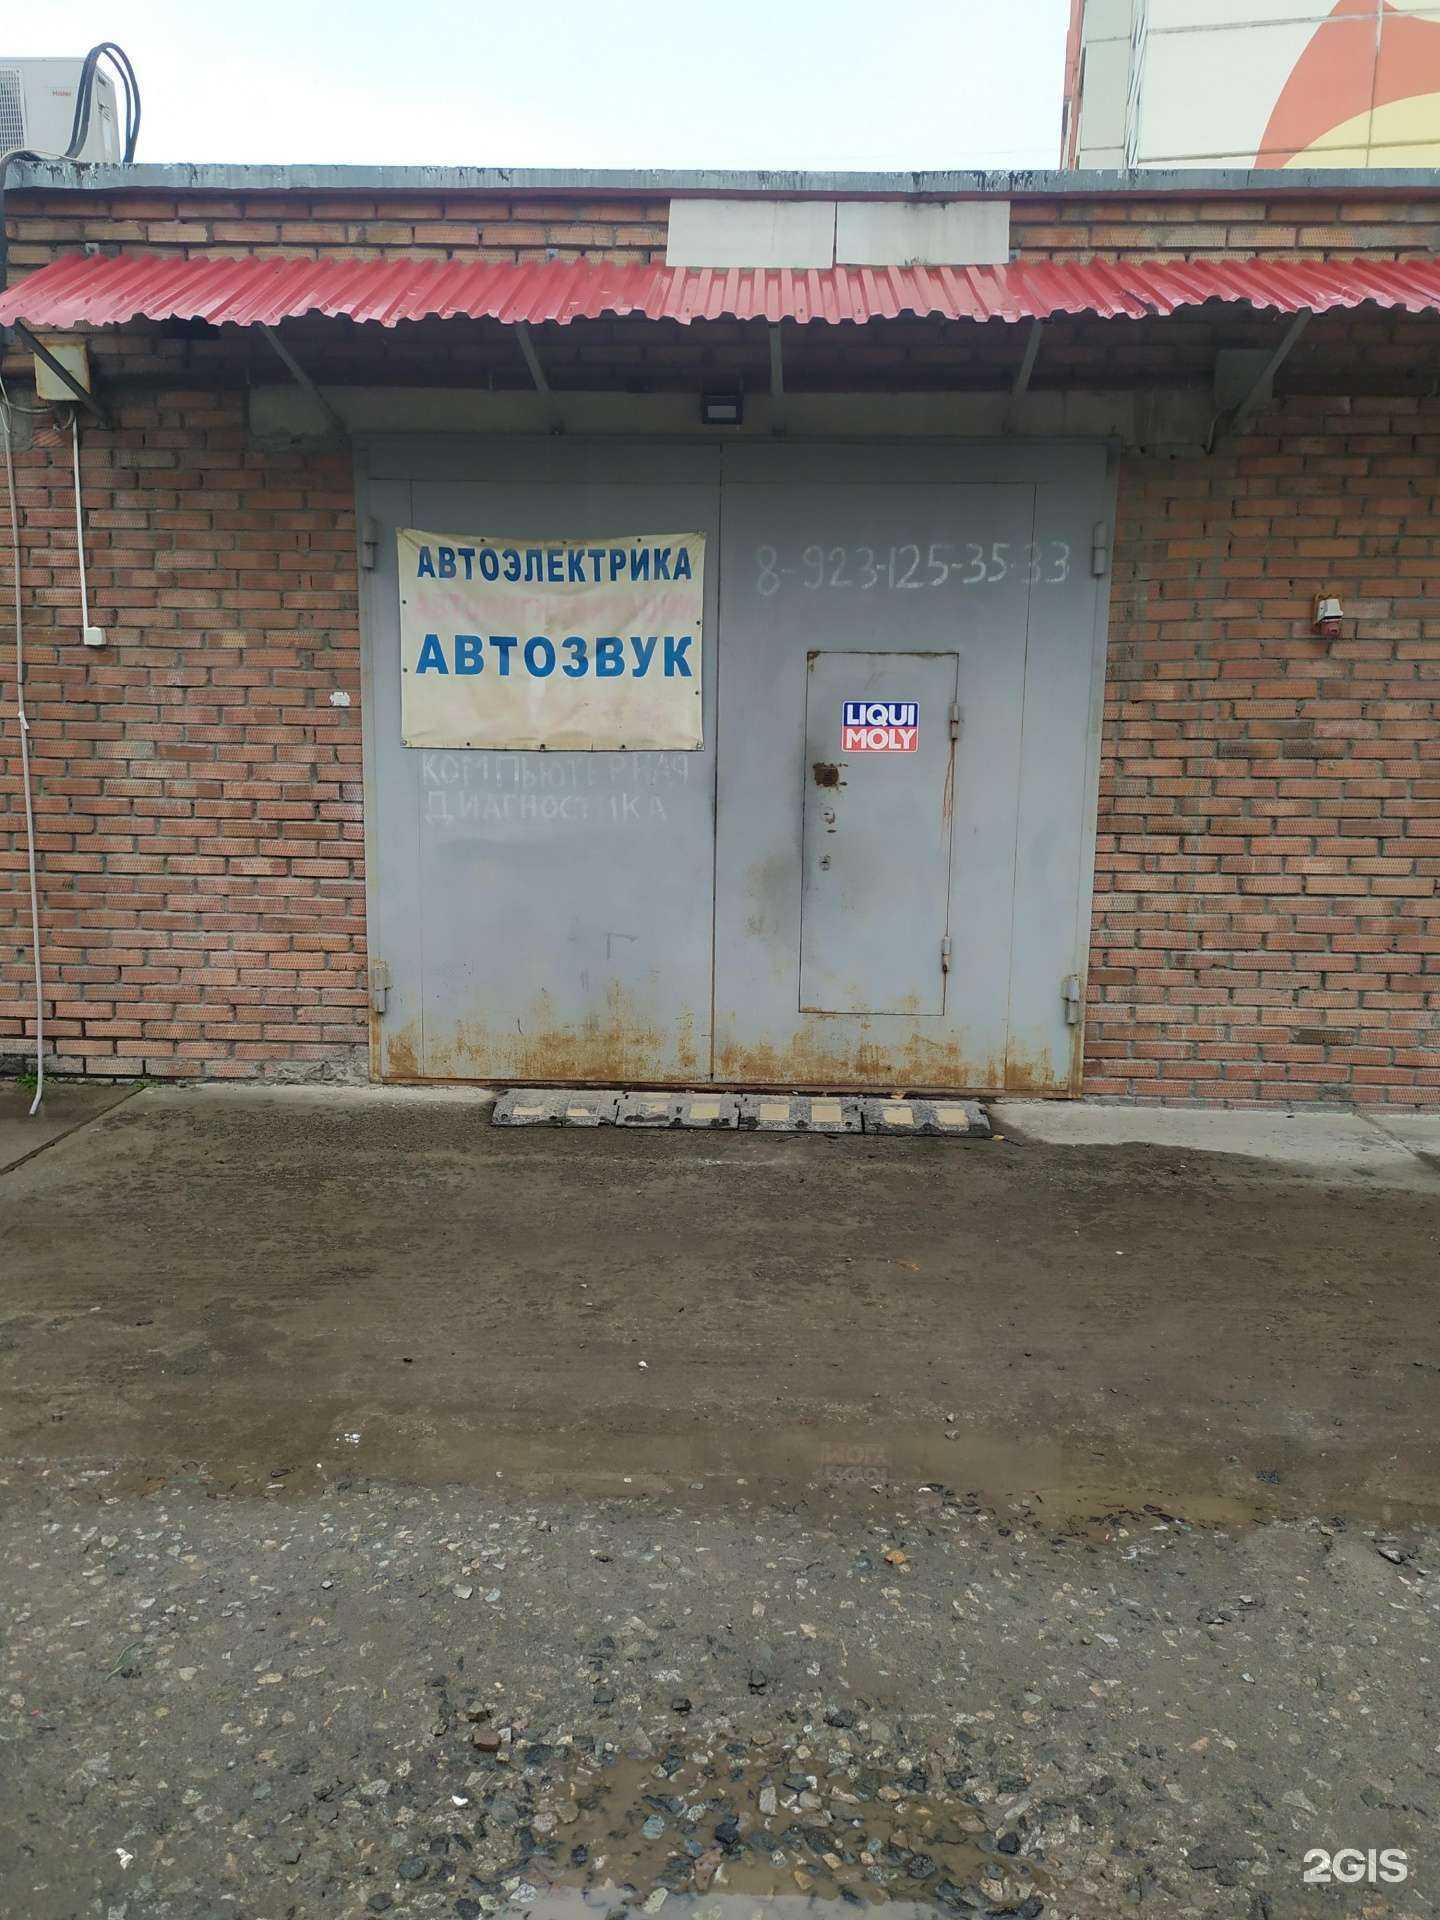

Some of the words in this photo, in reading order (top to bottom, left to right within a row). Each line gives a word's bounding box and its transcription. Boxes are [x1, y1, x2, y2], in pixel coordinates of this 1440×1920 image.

[417, 545, 692, 583] АВТОЭЛЕКТРИКА
[415, 633, 693, 678] АВТОЗВУК
[846, 704, 915, 726] LIQUI
[846, 728, 917, 750] MOLY
